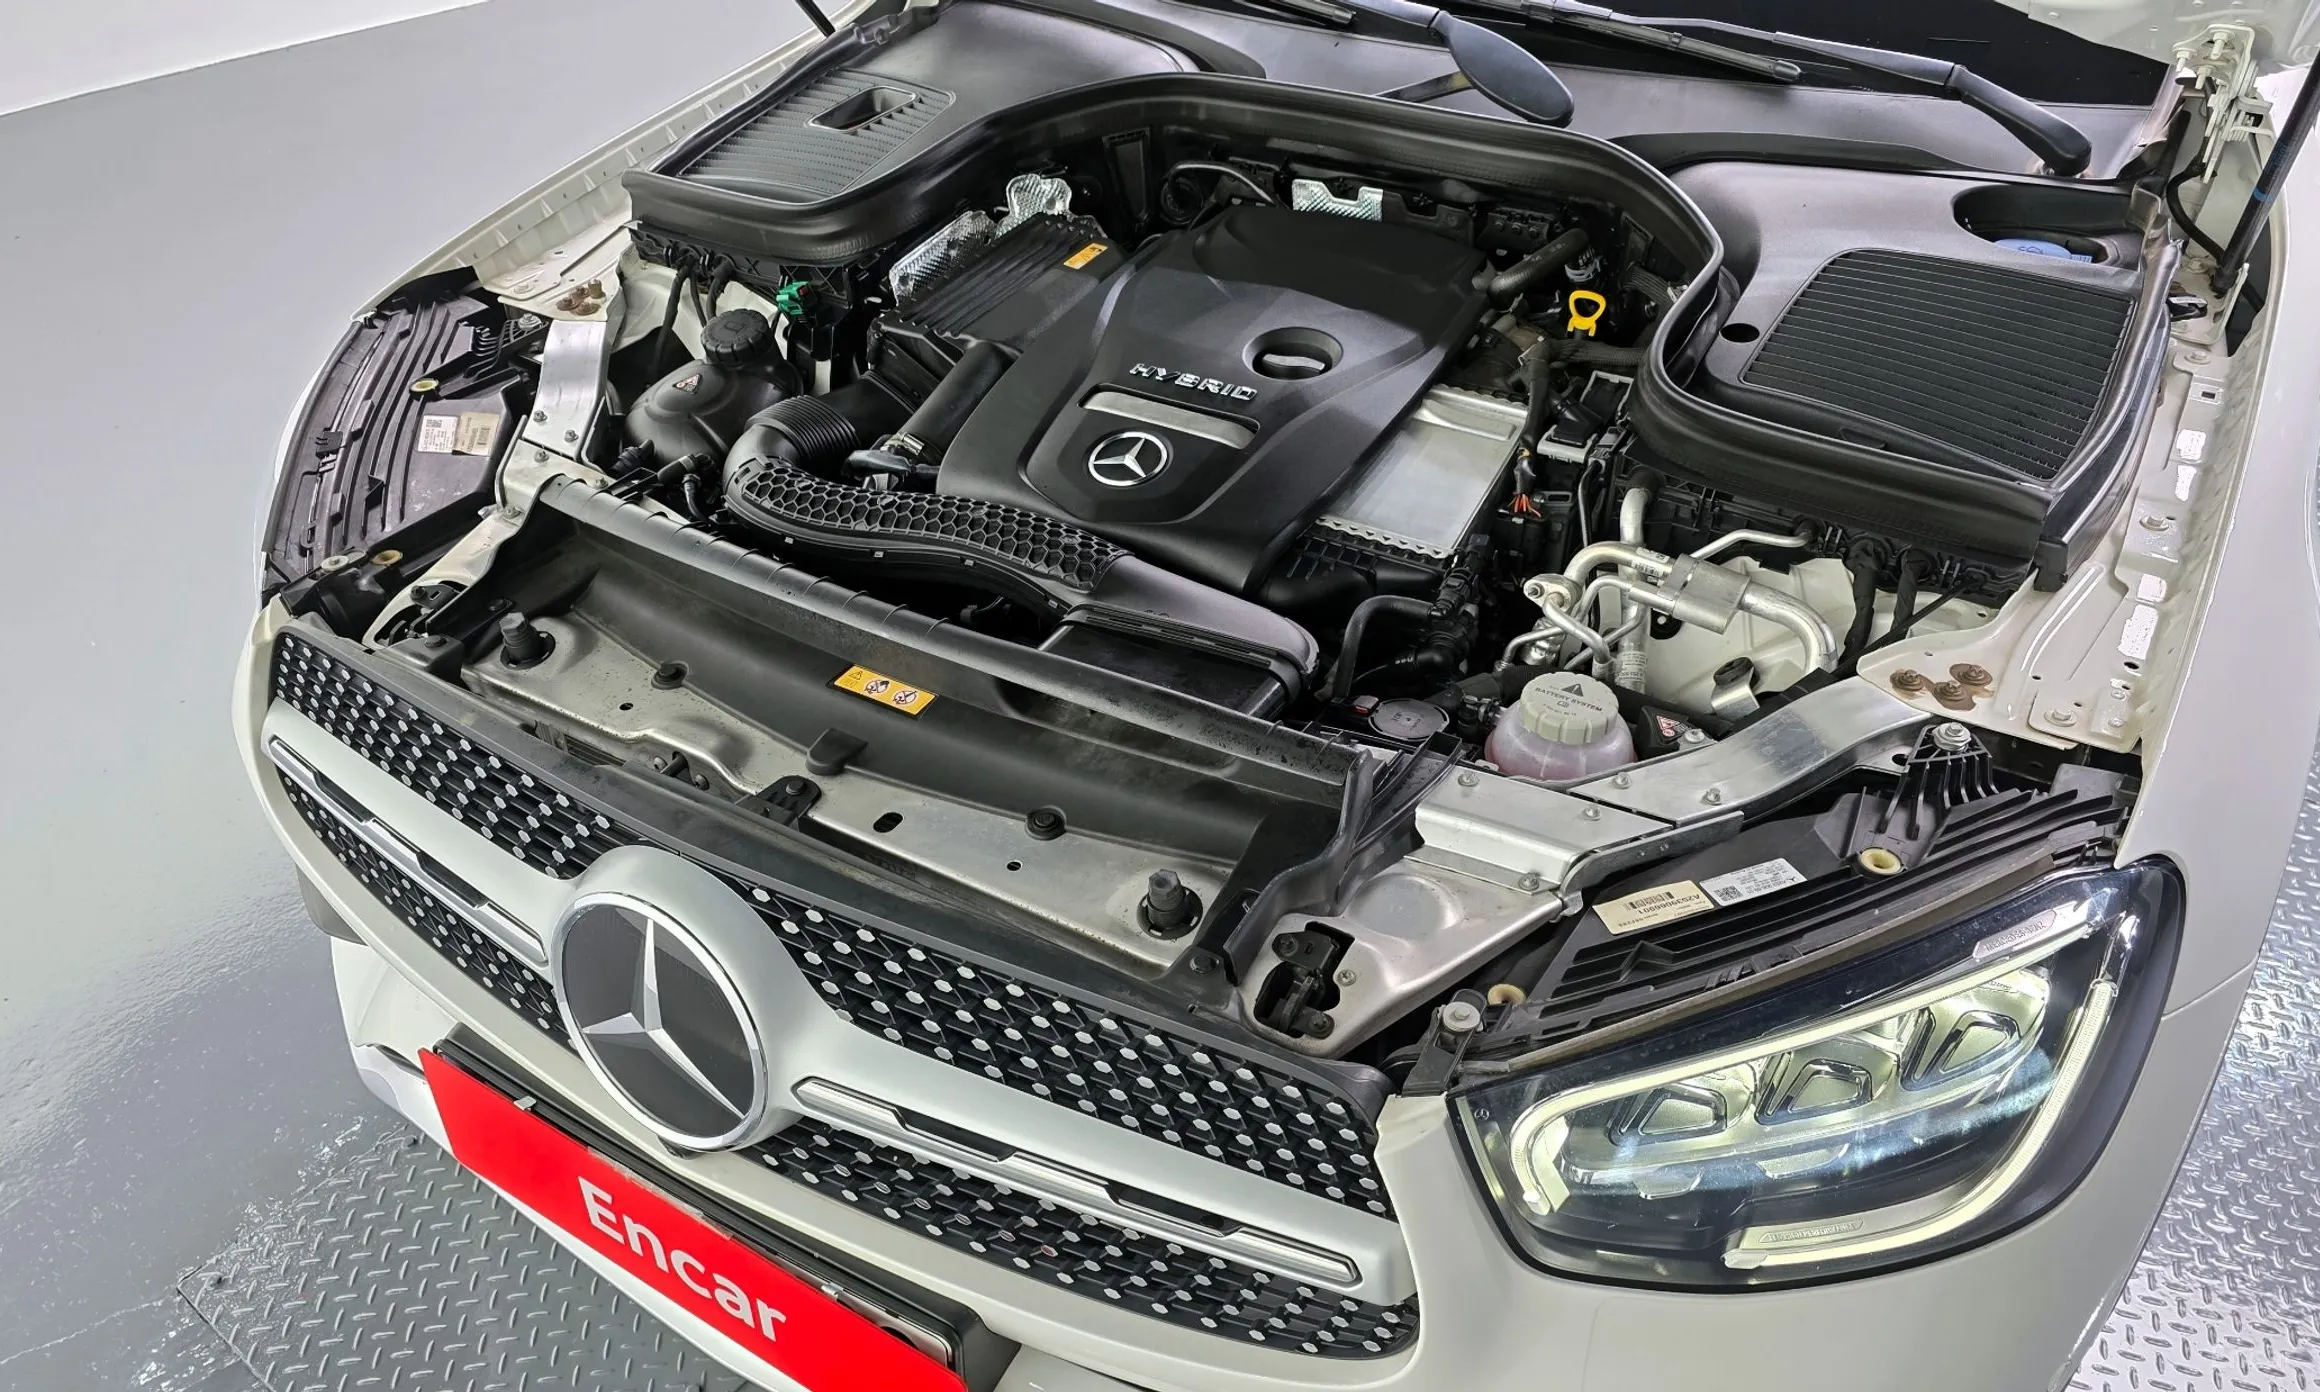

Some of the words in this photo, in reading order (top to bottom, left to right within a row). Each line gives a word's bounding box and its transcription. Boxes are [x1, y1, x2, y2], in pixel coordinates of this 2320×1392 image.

[1129, 363, 1258, 401] HYBRID
[1534, 687, 1571, 703] BATTERY
[1569, 698, 1603, 712] SYSTEM
[579, 1177, 787, 1343] Encar
